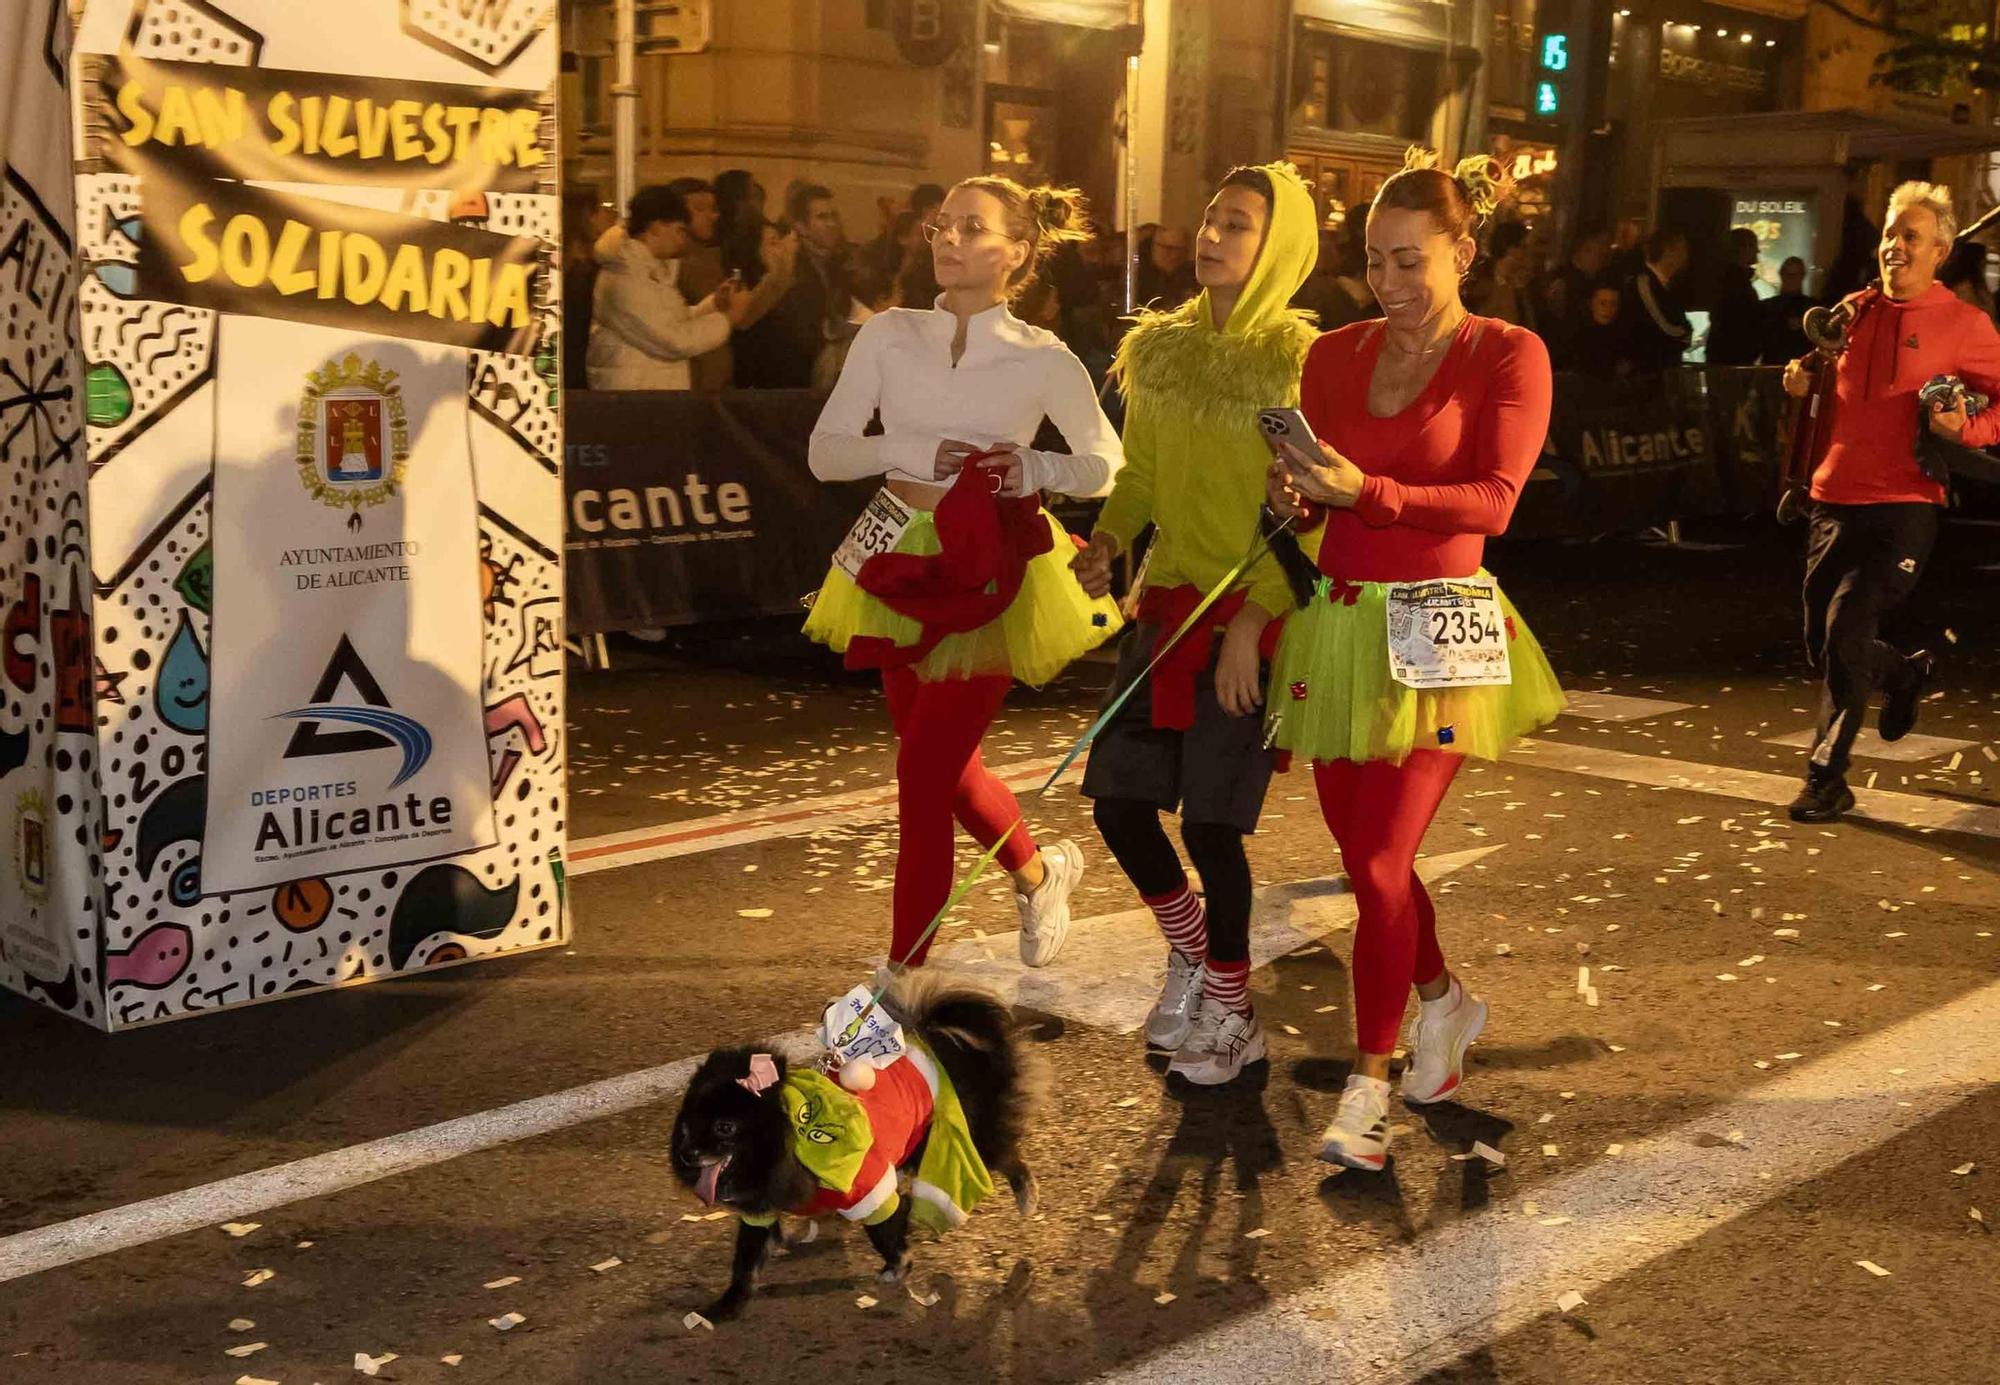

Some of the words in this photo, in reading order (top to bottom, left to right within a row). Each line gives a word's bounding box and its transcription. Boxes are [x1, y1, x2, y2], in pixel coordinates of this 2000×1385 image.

[117, 79, 247, 149] SAN
[267, 91, 546, 168] SILVESTRE
[179, 203, 532, 328] SOLIDARIA
[1582, 427, 1704, 467] Alicante
[279, 541, 419, 566] AYUNTAMIENTO
[296, 574, 321, 590] DE
[326, 565, 410, 588] ALICANTE
[1432, 610, 1500, 645] 2354
[251, 781, 357, 806] DEPORTES
[254, 793, 452, 851] Alicante
